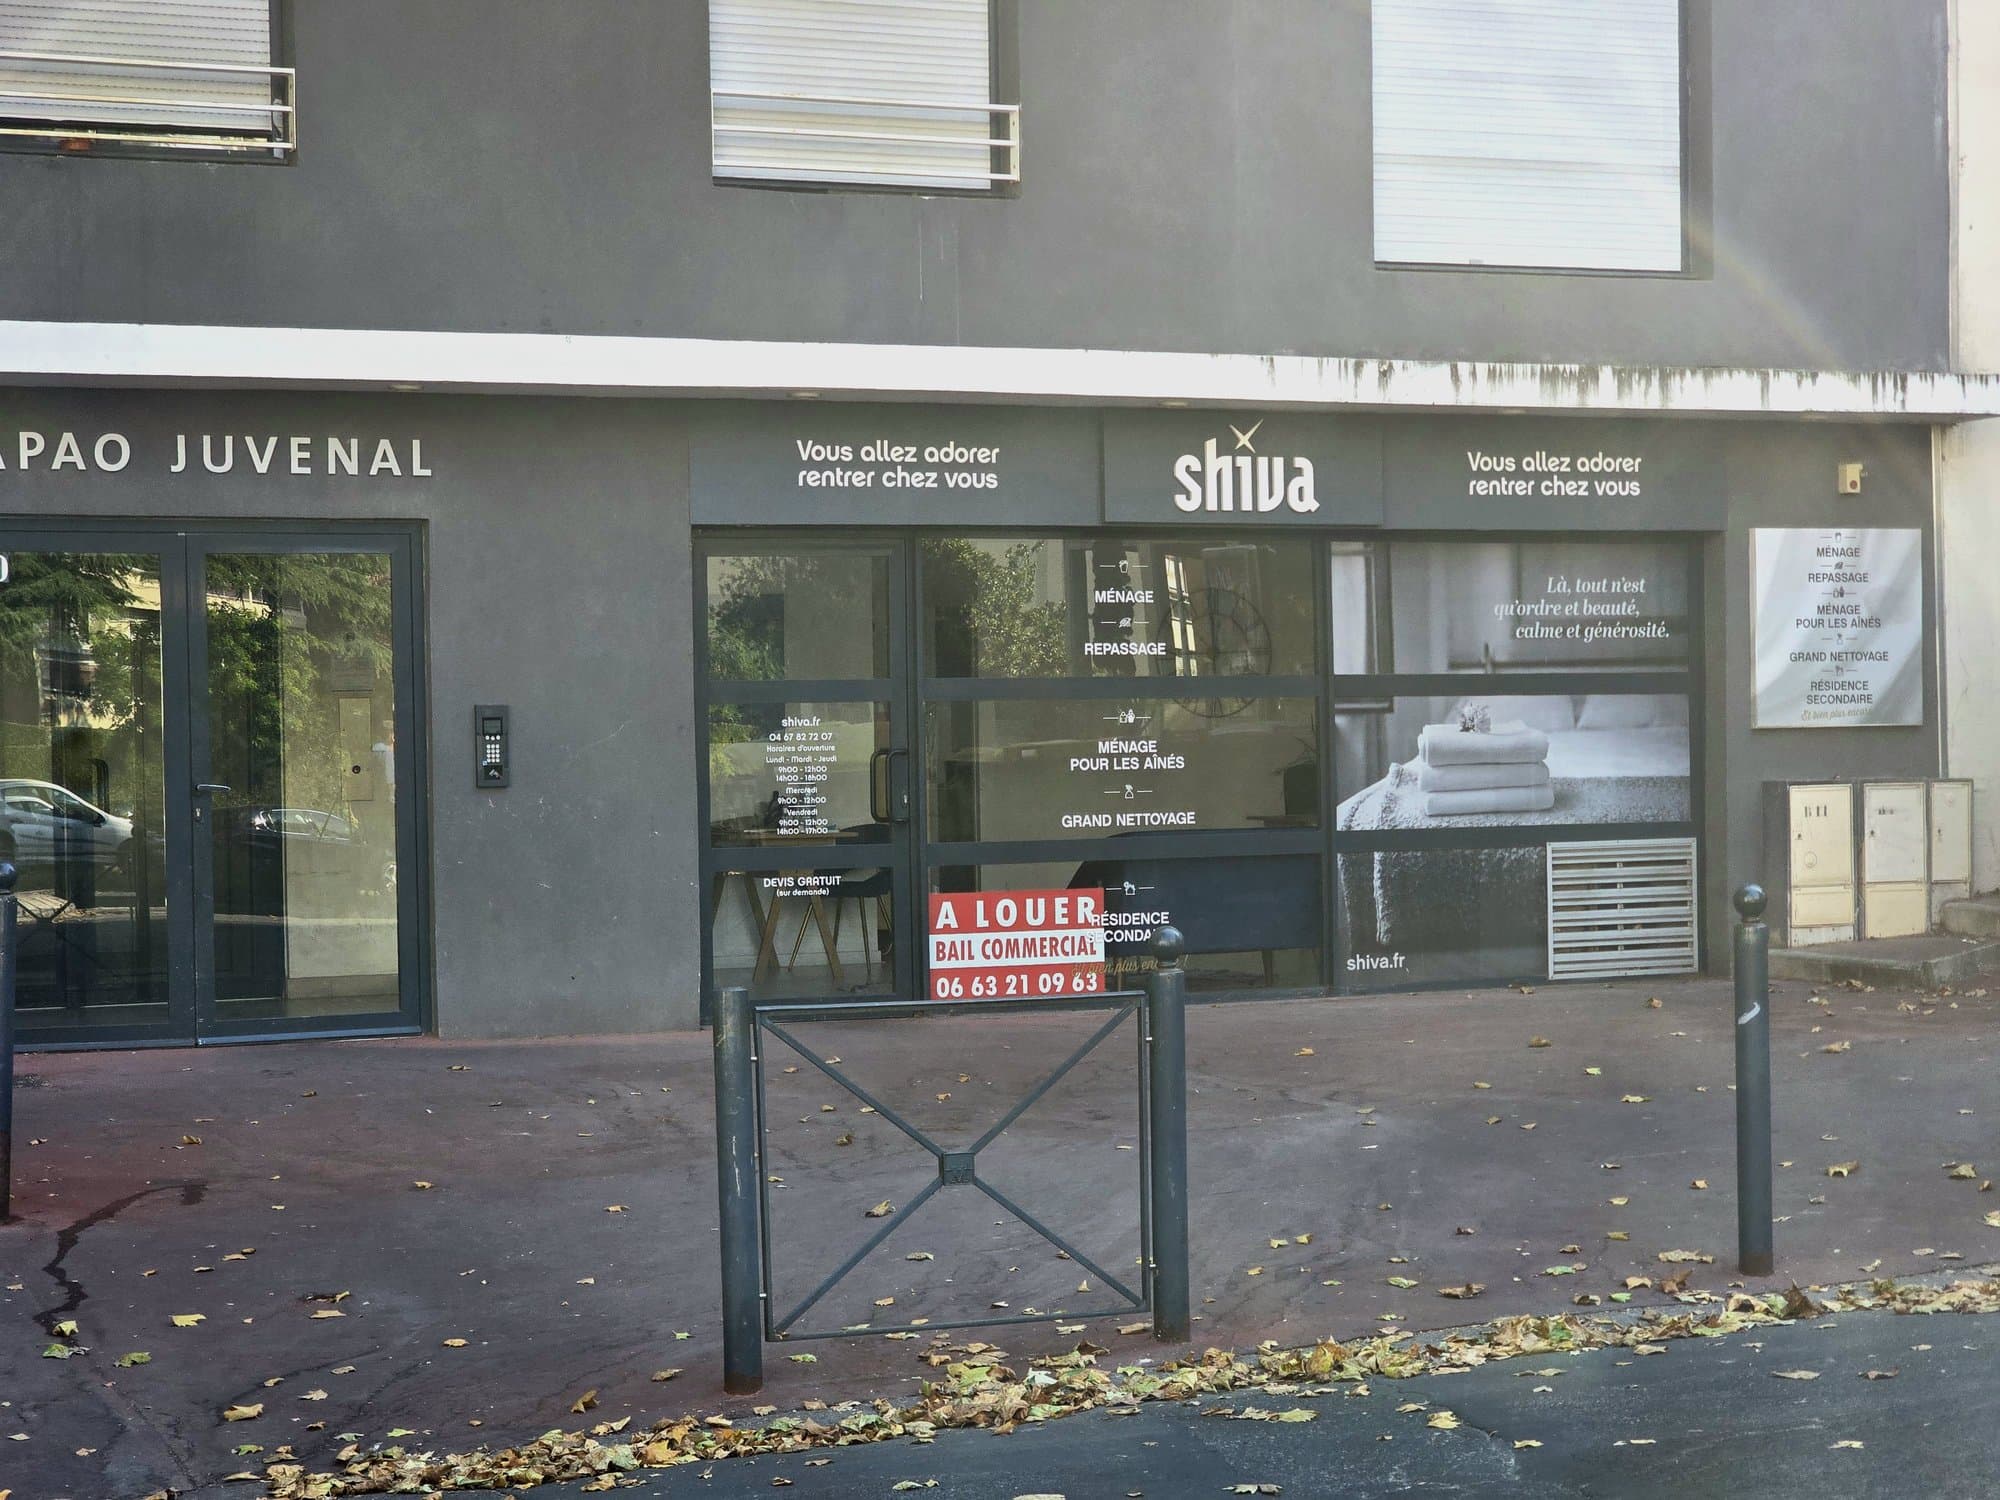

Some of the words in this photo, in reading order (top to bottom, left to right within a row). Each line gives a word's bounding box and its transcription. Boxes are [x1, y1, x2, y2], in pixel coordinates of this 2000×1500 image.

[0, 431, 131, 472] PAO
[170, 434, 432, 476] JUVENAL
[796, 440, 853, 461] Vous
[860, 440, 917, 462] allez
[924, 441, 1000, 464] adorer
[1174, 419, 1320, 513] shiva
[1467, 451, 1516, 471] Vous
[1522, 451, 1571, 472] allez
[1577, 451, 1642, 473] adorer
[798, 467, 875, 487] rentrer
[882, 465, 938, 488] chez
[944, 471, 998, 488] vous
[1469, 477, 1535, 496] rentrer
[1541, 475, 1588, 496] chez
[1594, 480, 1640, 496] vous
[1816, 545, 1861, 557] MÉNAGE
[1808, 572, 1869, 583] REPASSAGE
[1547, 576, 1571, 595] Là,
[1576, 577, 1607, 593] tout
[1611, 576, 1645, 593] n'est
[1095, 587, 1154, 603] MÉNAGE
[1494, 600, 1561, 621] qu'ordre
[1564, 601, 1579, 616] et
[1583, 599, 1640, 618] beauté,
[1816, 602, 1861, 615] MÉNAGE
[1796, 618, 1825, 629] POUR
[1828, 618, 1847, 629] LES
[1850, 616, 1881, 628] AÎNÉS
[1516, 621, 1563, 639] calme
[1566, 623, 1581, 639] et
[1583, 621, 1670, 643] générosité.
[1084, 642, 1167, 656] REPASSAGE
[1789, 652, 1827, 662] GRAND
[1830, 651, 1889, 662] NETTOYAGE
[1810, 679, 1869, 691] RÉSIDENCE
[1806, 694, 1873, 704] SECONDAIRE
[781, 716, 821, 727] shiva.fr
[768, 733, 781, 742] 04
[783, 732, 794, 742] 67
[808, 732, 819, 741] 72
[820, 732, 833, 741] 07
[766, 745, 796, 753] Horaires
[797, 744, 836, 752] d'ouverture
[1098, 737, 1157, 754] MÉNAGE
[765, 755, 785, 763] Lundi
[791, 755, 813, 763] Mardi
[1070, 757, 1109, 772] POUR
[1113, 757, 1140, 770] LES
[1143, 753, 1185, 769] AÎNÉS
[804, 765, 828, 773] 12h00
[803, 796, 827, 804] 12h00
[1061, 814, 1112, 828] GRAND
[1116, 811, 1196, 826] NETTOYAGE
[763, 877, 795, 888] DEVIS
[797, 875, 842, 887] GRATUIT
[776, 888, 791, 897] (sur
[792, 887, 830, 896] demande)
[936, 901, 959, 929] A
[976, 896, 1096, 928] LOUER
[1091, 911, 1169, 926] RÉSIDENCE
[1087, 928, 1156, 943] SECONDA
[936, 937, 975, 962] BAIL
[982, 932, 1097, 960] COMMERCIAL
[1113, 957, 1139, 976] plus
[1346, 952, 1406, 971] shiva.fr
[936, 976, 964, 998] 06
[971, 974, 997, 996] 63
[1005, 973, 1029, 995] 21
[1038, 972, 1065, 994] 09
[1072, 970, 1098, 993] 63
